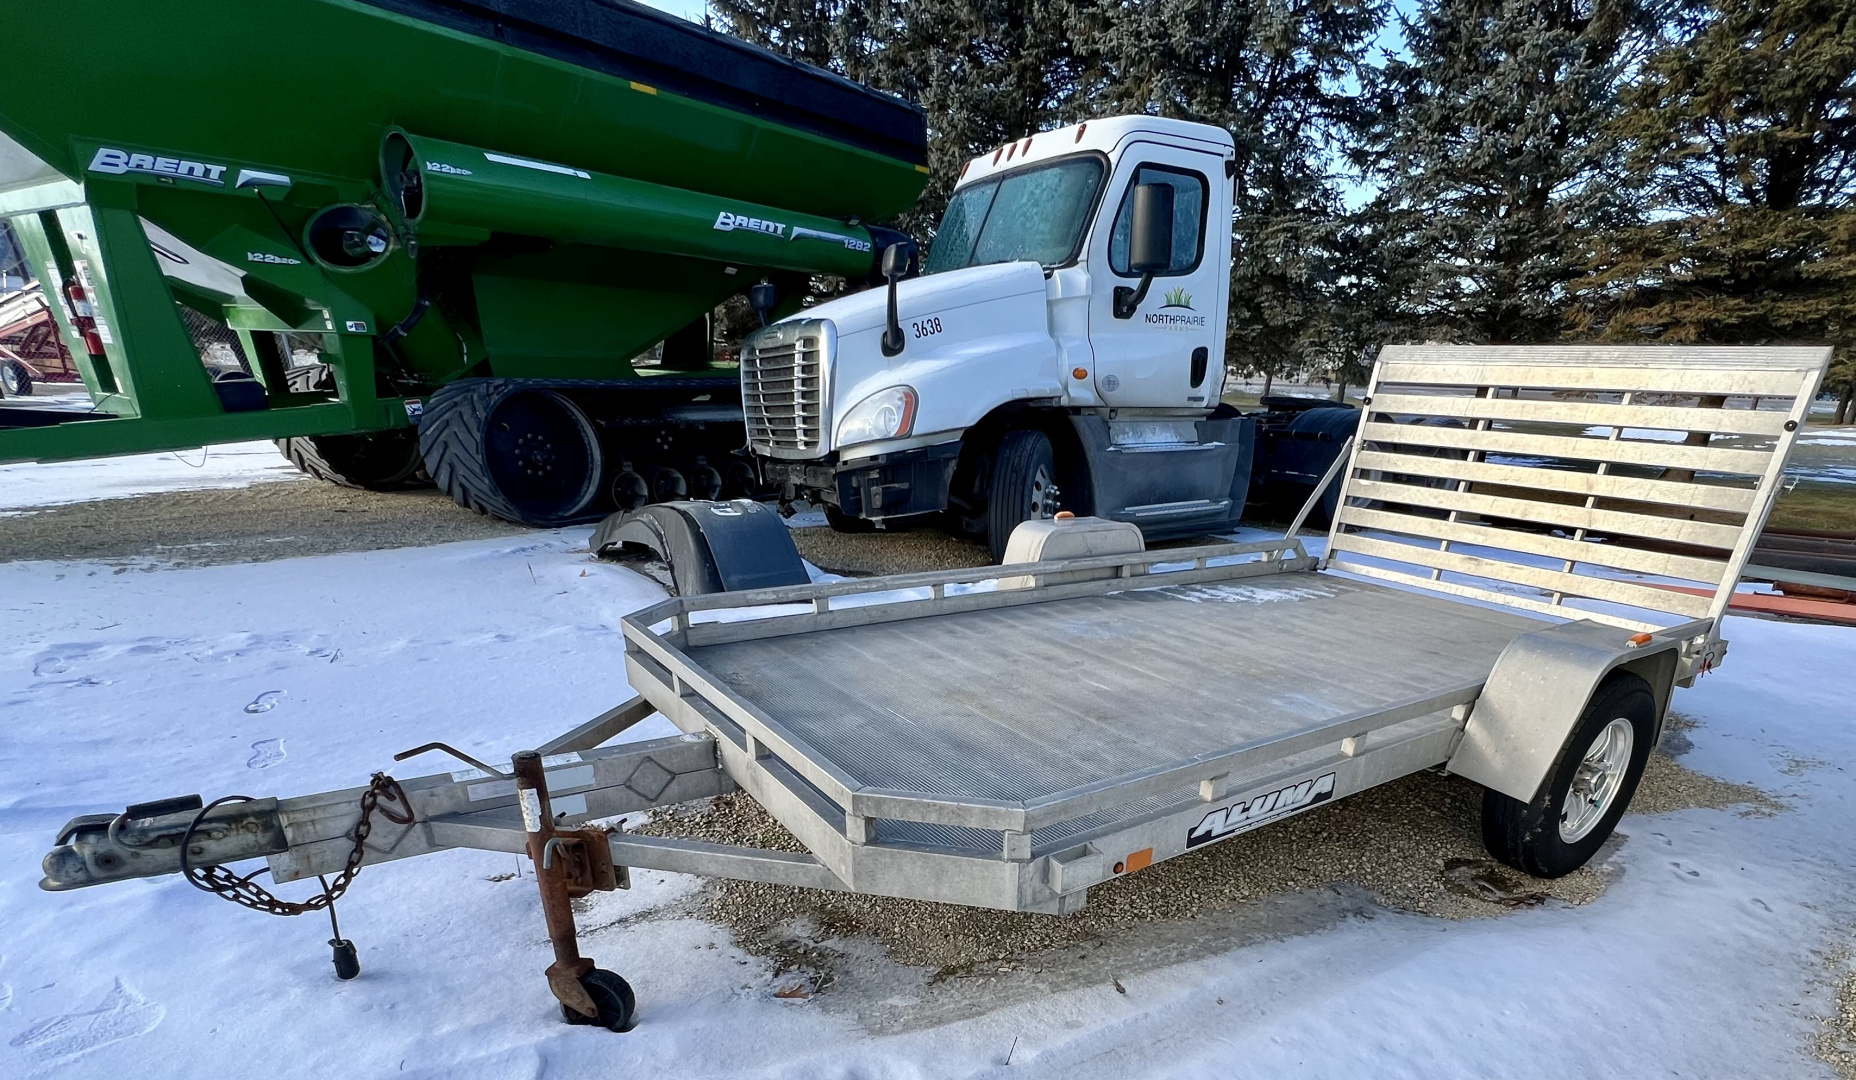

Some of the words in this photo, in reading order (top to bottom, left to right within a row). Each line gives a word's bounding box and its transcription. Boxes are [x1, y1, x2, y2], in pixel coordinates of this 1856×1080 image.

[88, 147, 227, 183] BRENT
[713, 211, 786, 237] BRENT
[843, 238, 872, 253] 1282
[912, 316, 943, 339] 3638
[1190, 772, 1335, 838] ALUMA
